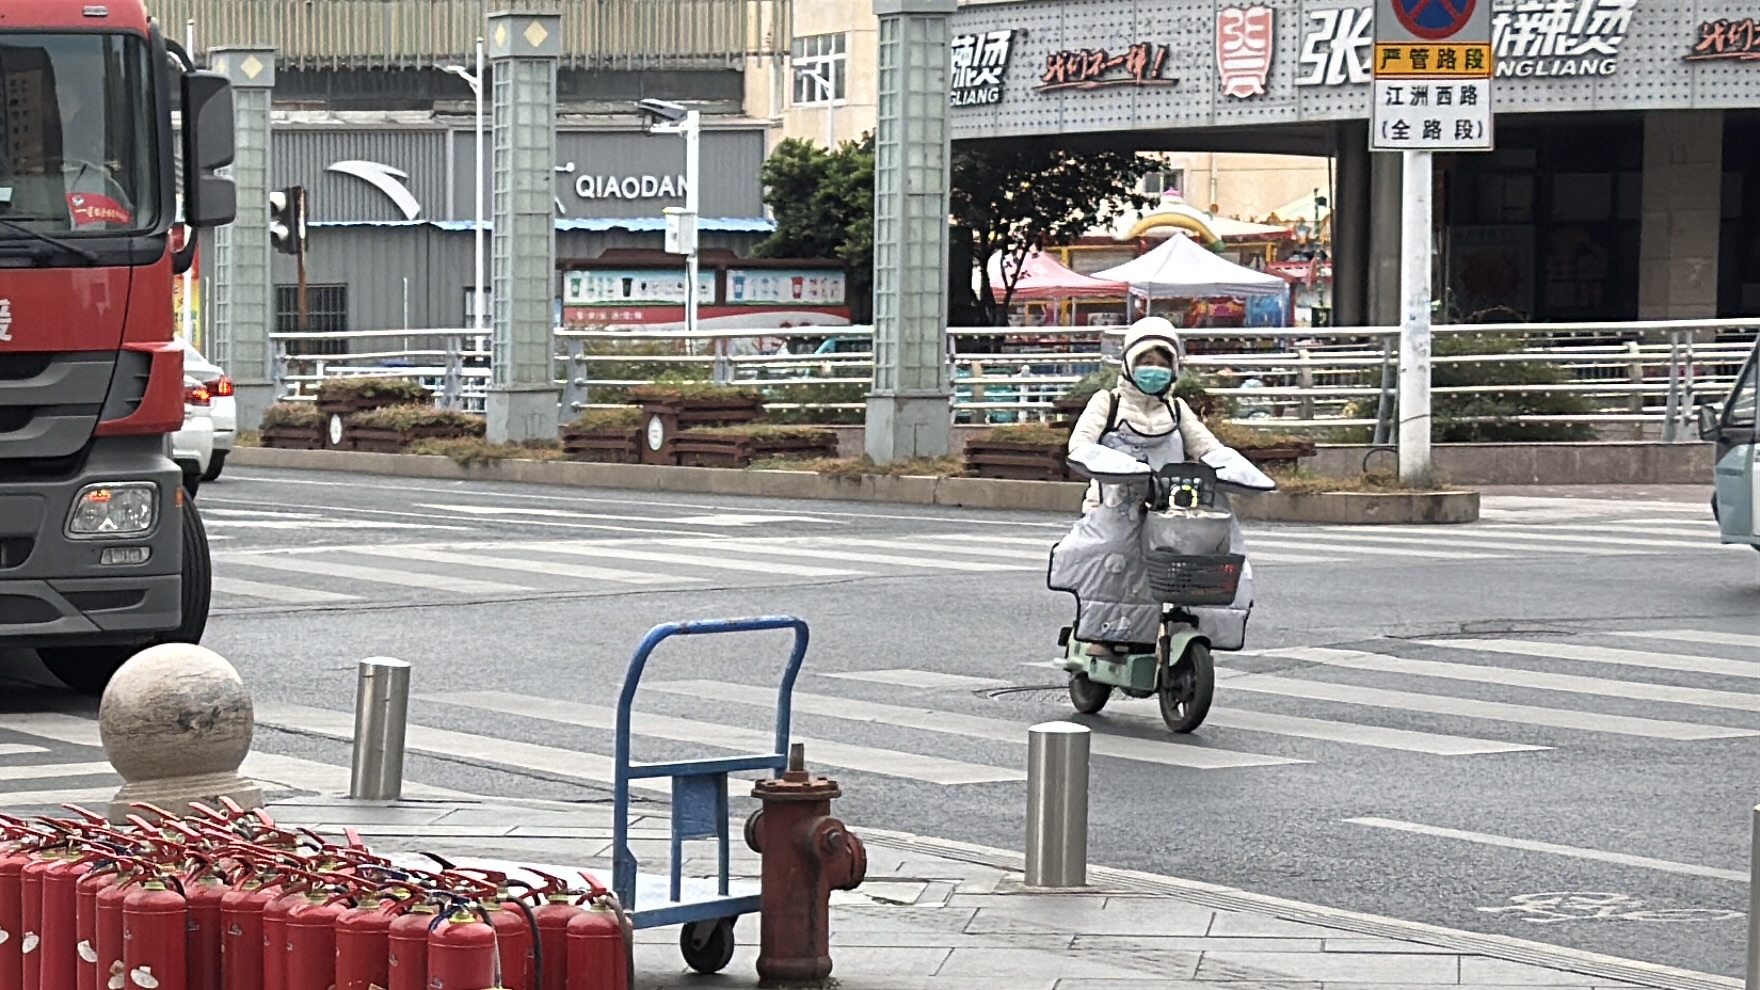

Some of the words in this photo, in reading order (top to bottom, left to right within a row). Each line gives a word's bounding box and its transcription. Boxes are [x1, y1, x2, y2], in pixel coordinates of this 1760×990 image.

[1381, 48, 1484, 70] 严管路段
[1495, 59, 1617, 77] NGLIANG
[1386, 85, 1477, 106] 江洲西路
